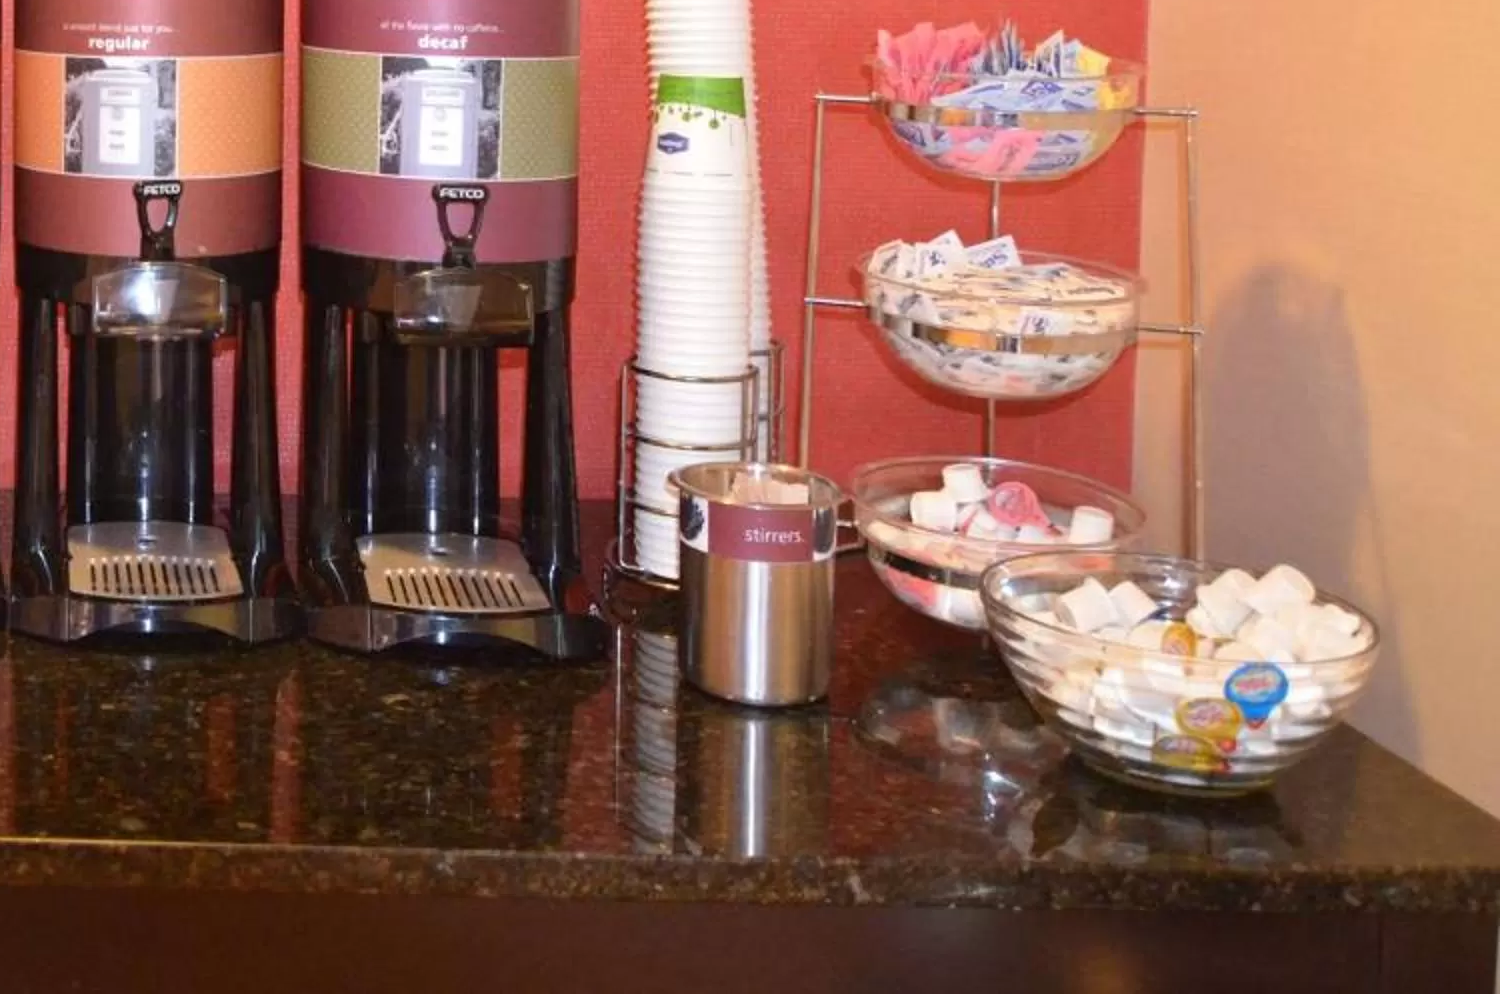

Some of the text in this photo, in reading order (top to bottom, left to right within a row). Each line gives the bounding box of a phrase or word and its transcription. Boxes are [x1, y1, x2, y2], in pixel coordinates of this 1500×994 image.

[87, 35, 149, 53] regular
[417, 34, 468, 51] decaf
[143, 184, 181, 196] FETCO
[440, 187, 485, 199] FETCO
[742, 526, 804, 544] stirrers.
